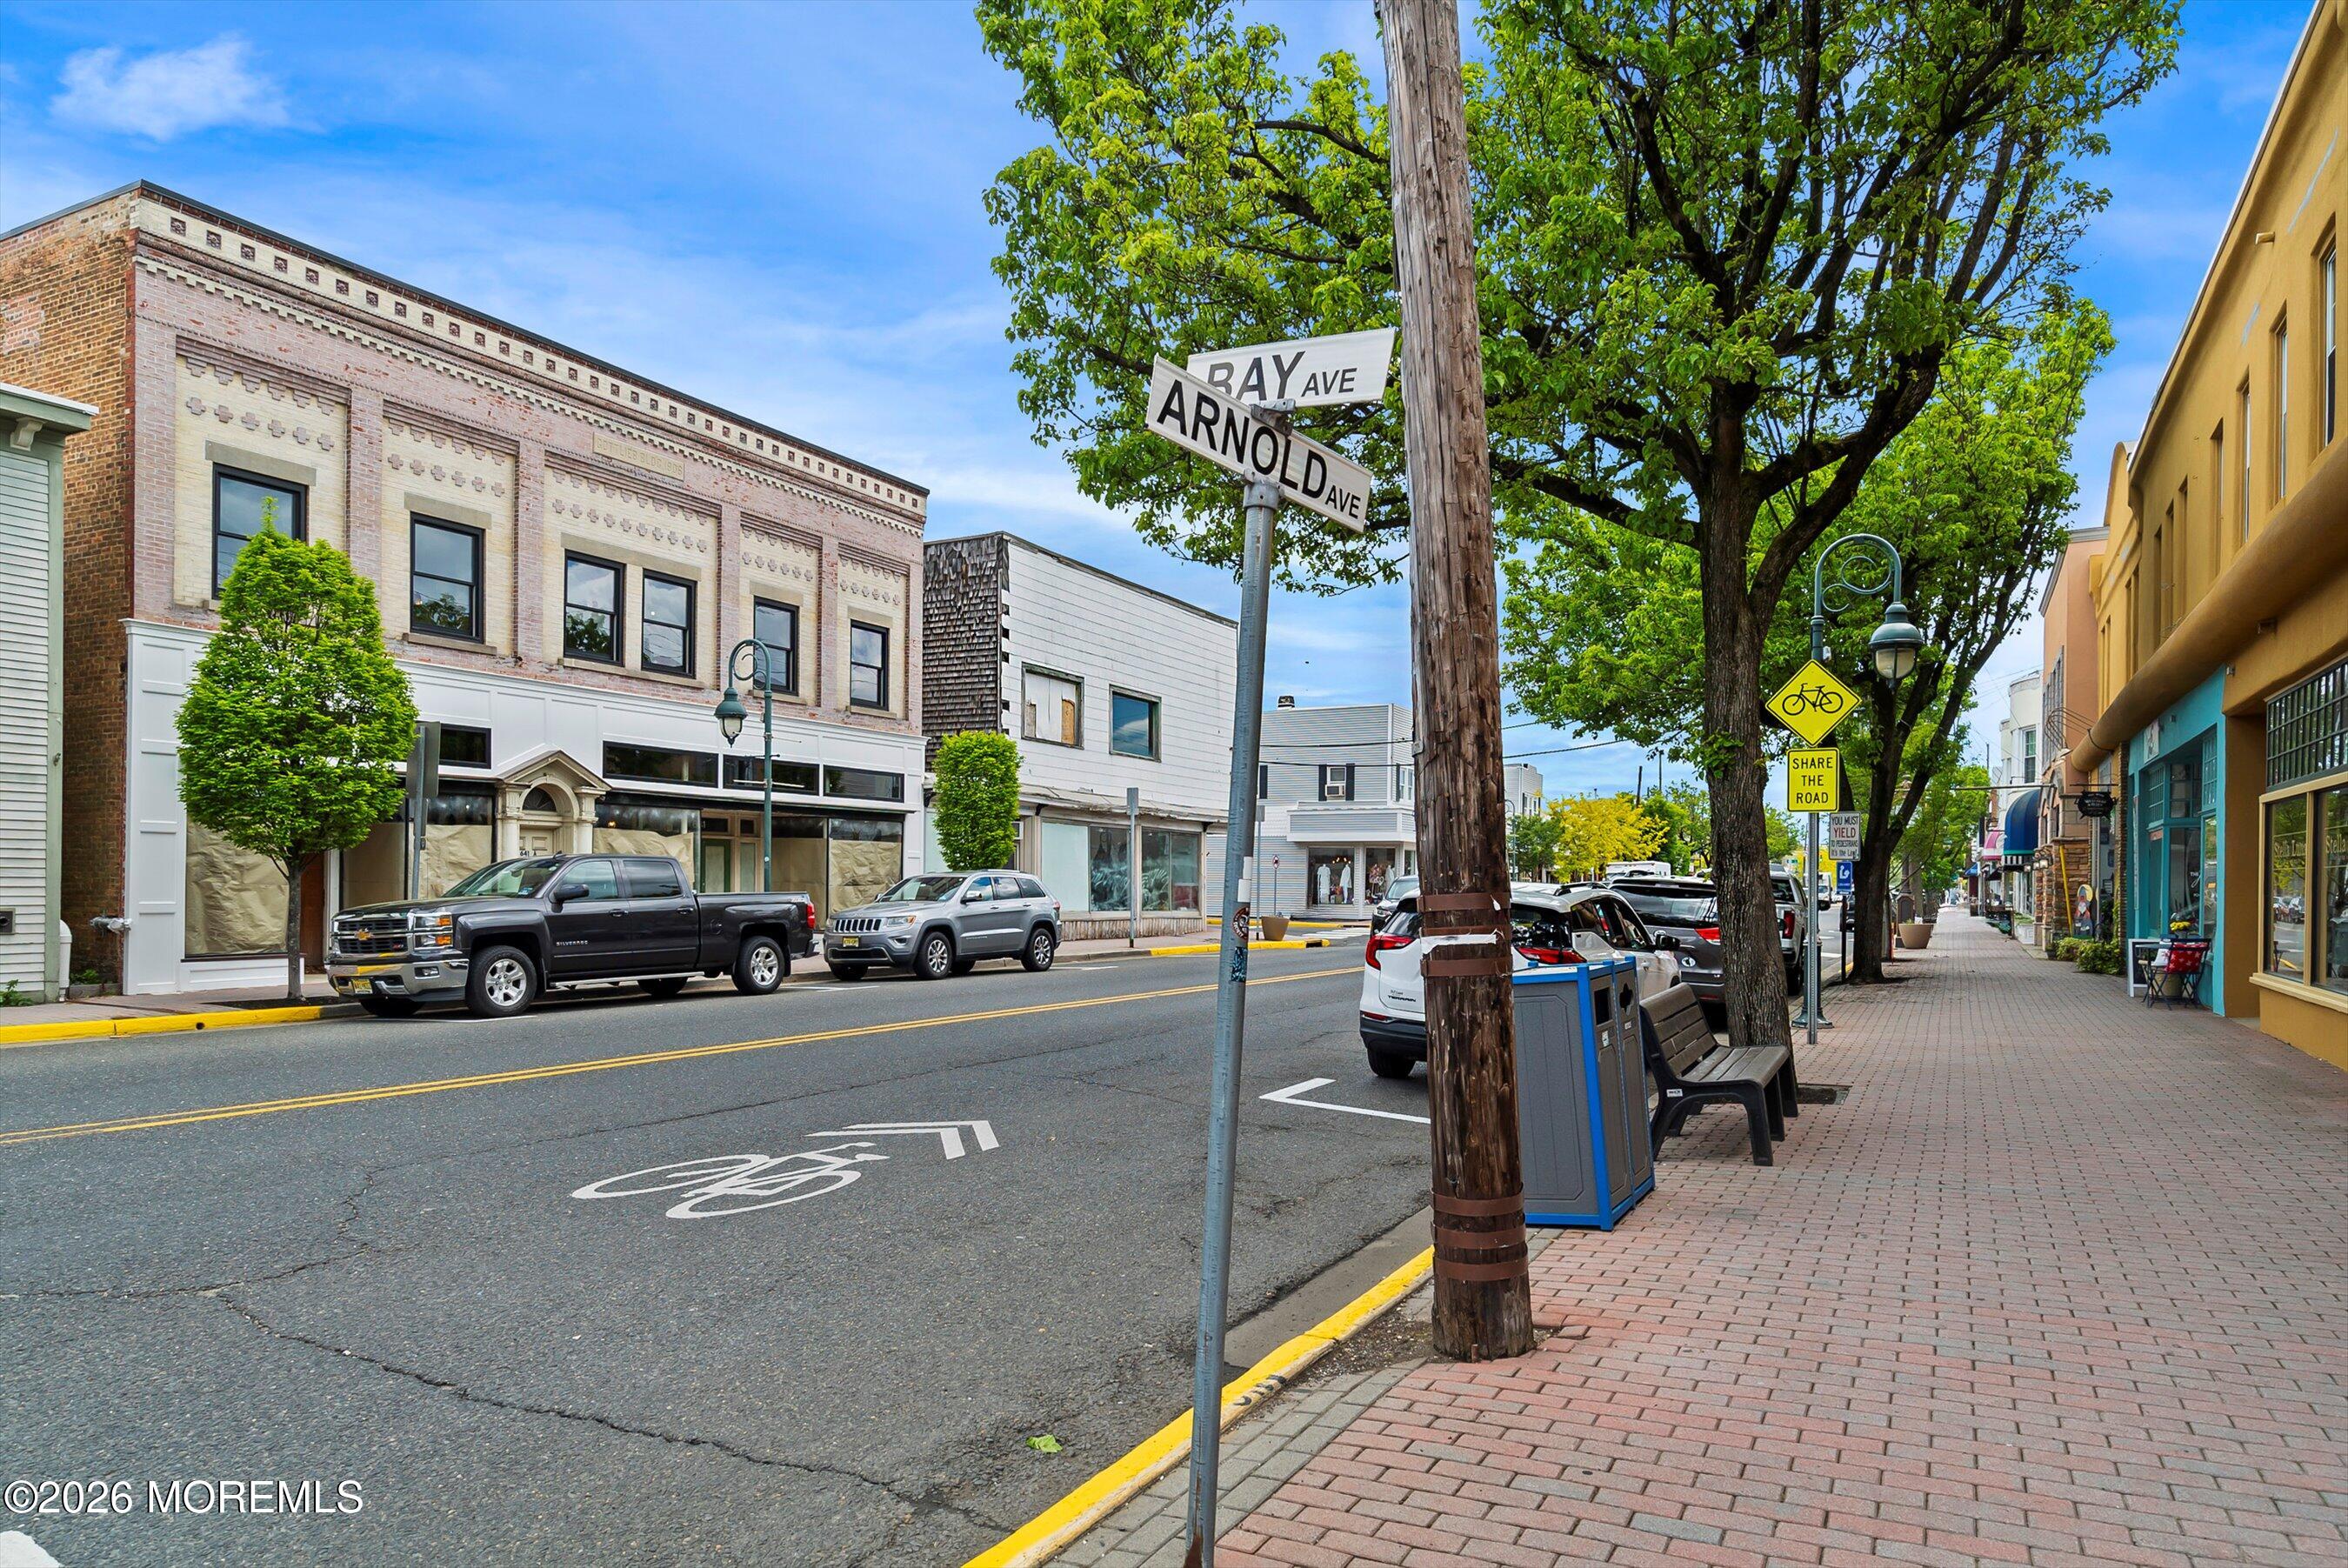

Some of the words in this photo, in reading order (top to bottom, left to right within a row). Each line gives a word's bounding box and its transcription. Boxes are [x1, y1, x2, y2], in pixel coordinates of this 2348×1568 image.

[1206, 350, 1305, 401] BAY
[1302, 368, 1357, 397] AVE
[1157, 379, 1328, 499] ARNOLD
[1325, 485, 1361, 519] AVE
[1792, 757, 1833, 770] SHARE
[1801, 775, 1824, 786] THE
[1796, 791, 1829, 804] ROAD
[1831, 817, 1843, 825] YOU
[1844, 817, 1858, 825] MUST
[1833, 827, 1856, 837] YIELD
[2325, 834, 2346, 853] Stella
[1388, 994, 1416, 1003] TERRAIN
